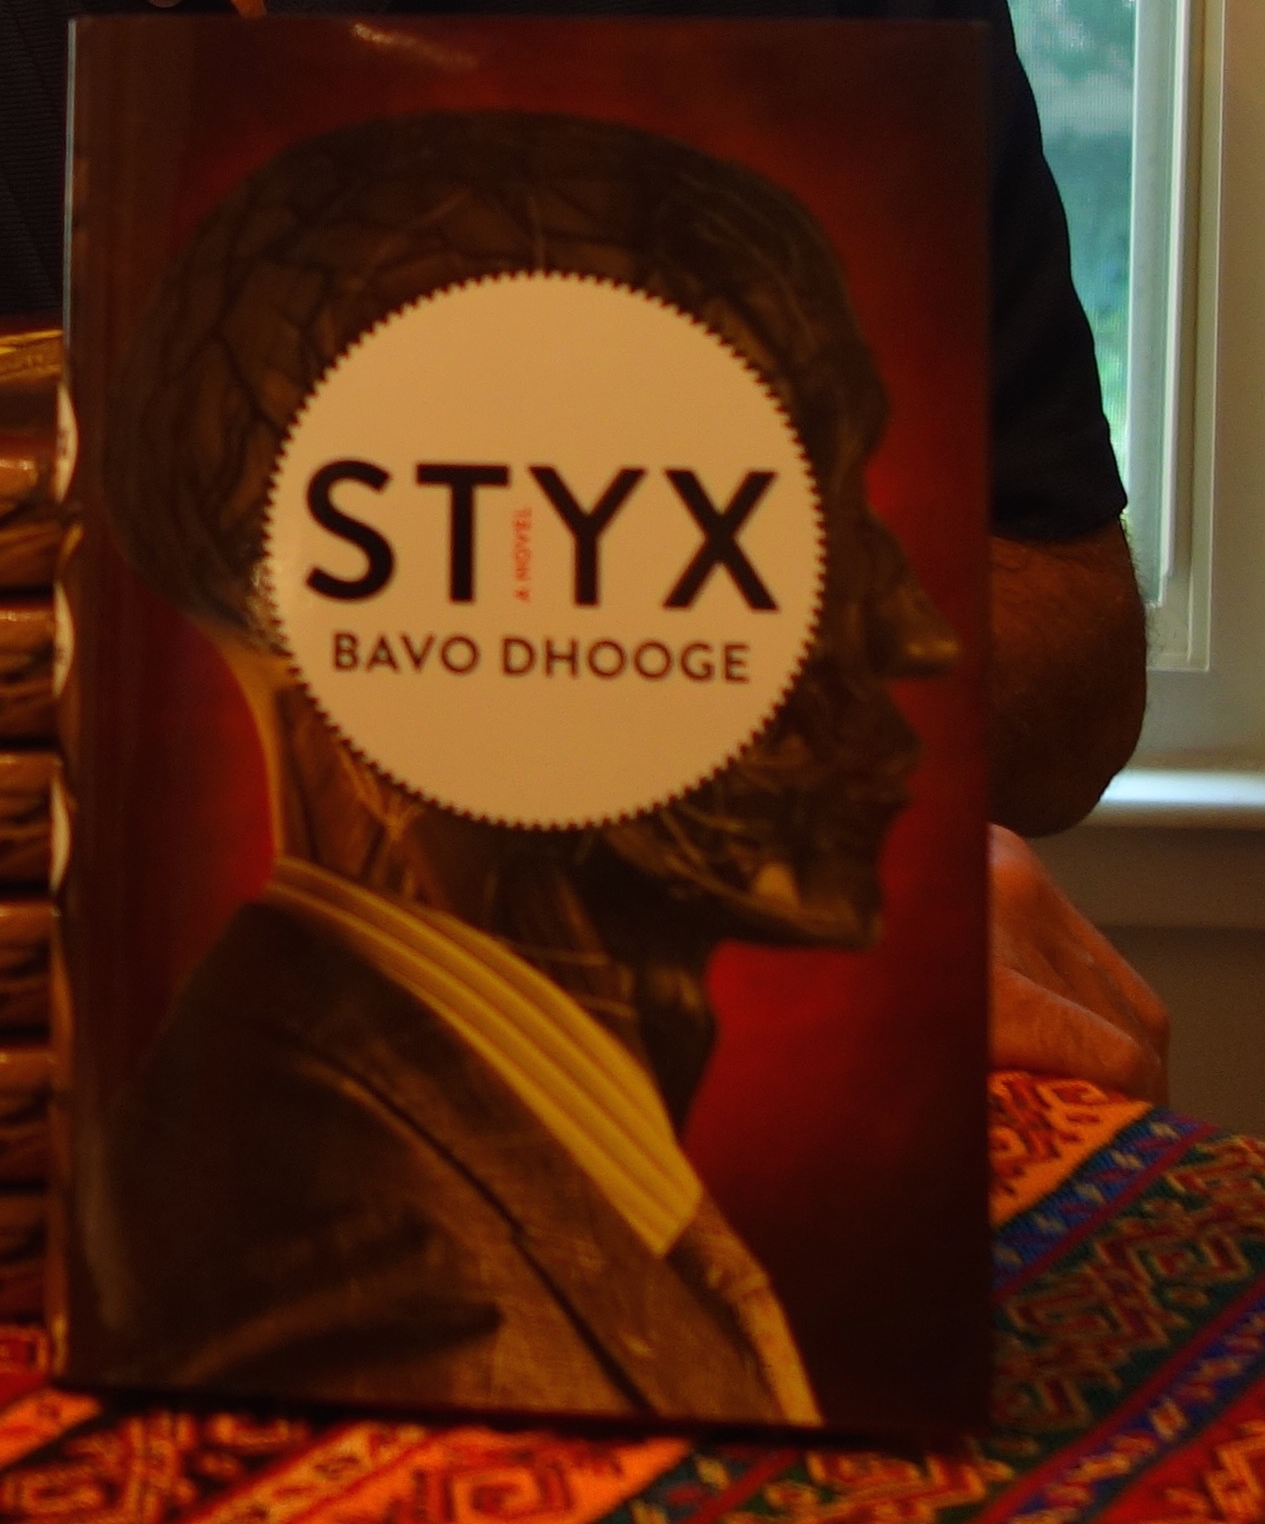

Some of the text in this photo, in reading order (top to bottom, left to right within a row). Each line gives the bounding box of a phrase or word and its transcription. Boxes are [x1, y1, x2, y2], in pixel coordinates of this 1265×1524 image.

[306, 460, 778, 612] STYX
[512, 507, 532, 581] NOVEL
[333, 633, 750, 683] BAVO DHOOGE
